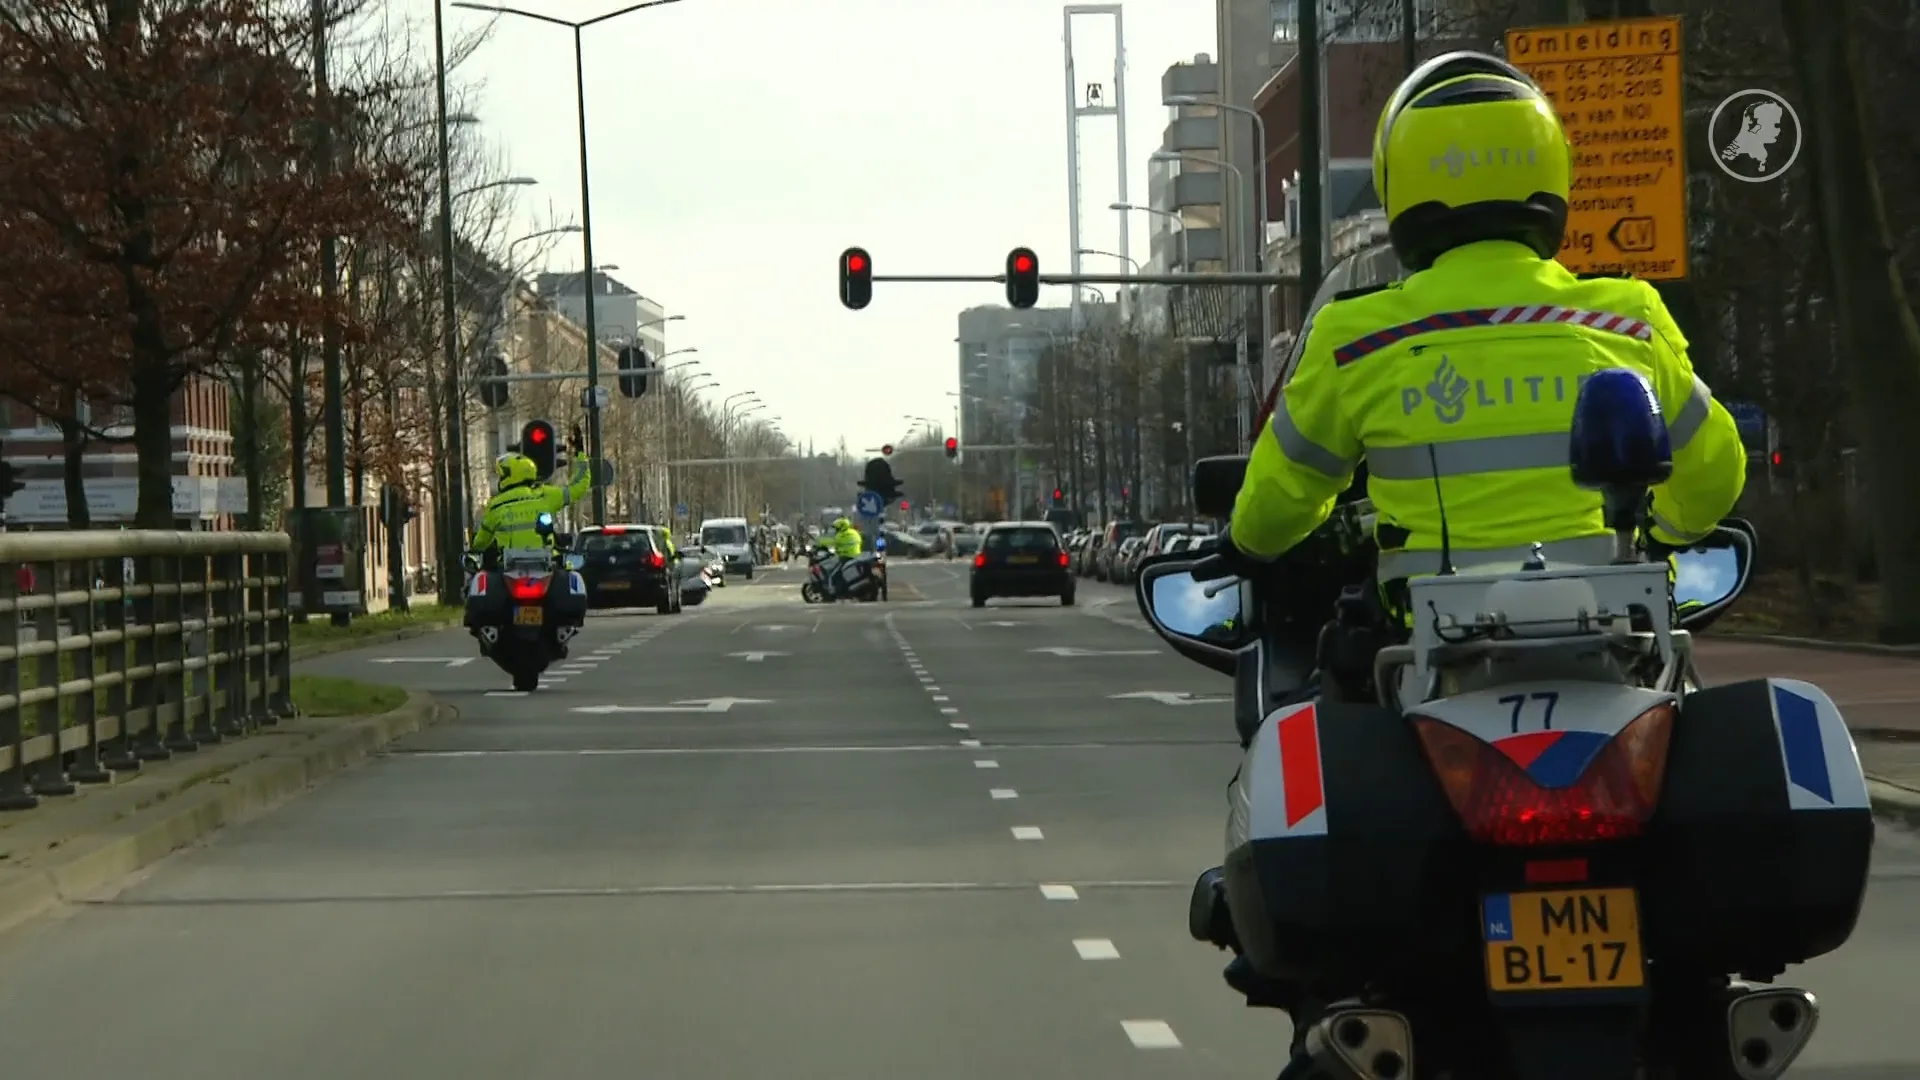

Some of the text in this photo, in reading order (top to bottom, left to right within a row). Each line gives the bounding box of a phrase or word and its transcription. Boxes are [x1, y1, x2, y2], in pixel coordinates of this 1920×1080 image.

[1514, 27, 1672, 54] Omleiding
[1568, 196, 1635, 212] oorburg
[1499, 692, 1559, 732] 77
[1490, 922, 1508, 935] NL
[1541, 896, 1608, 934] MN
